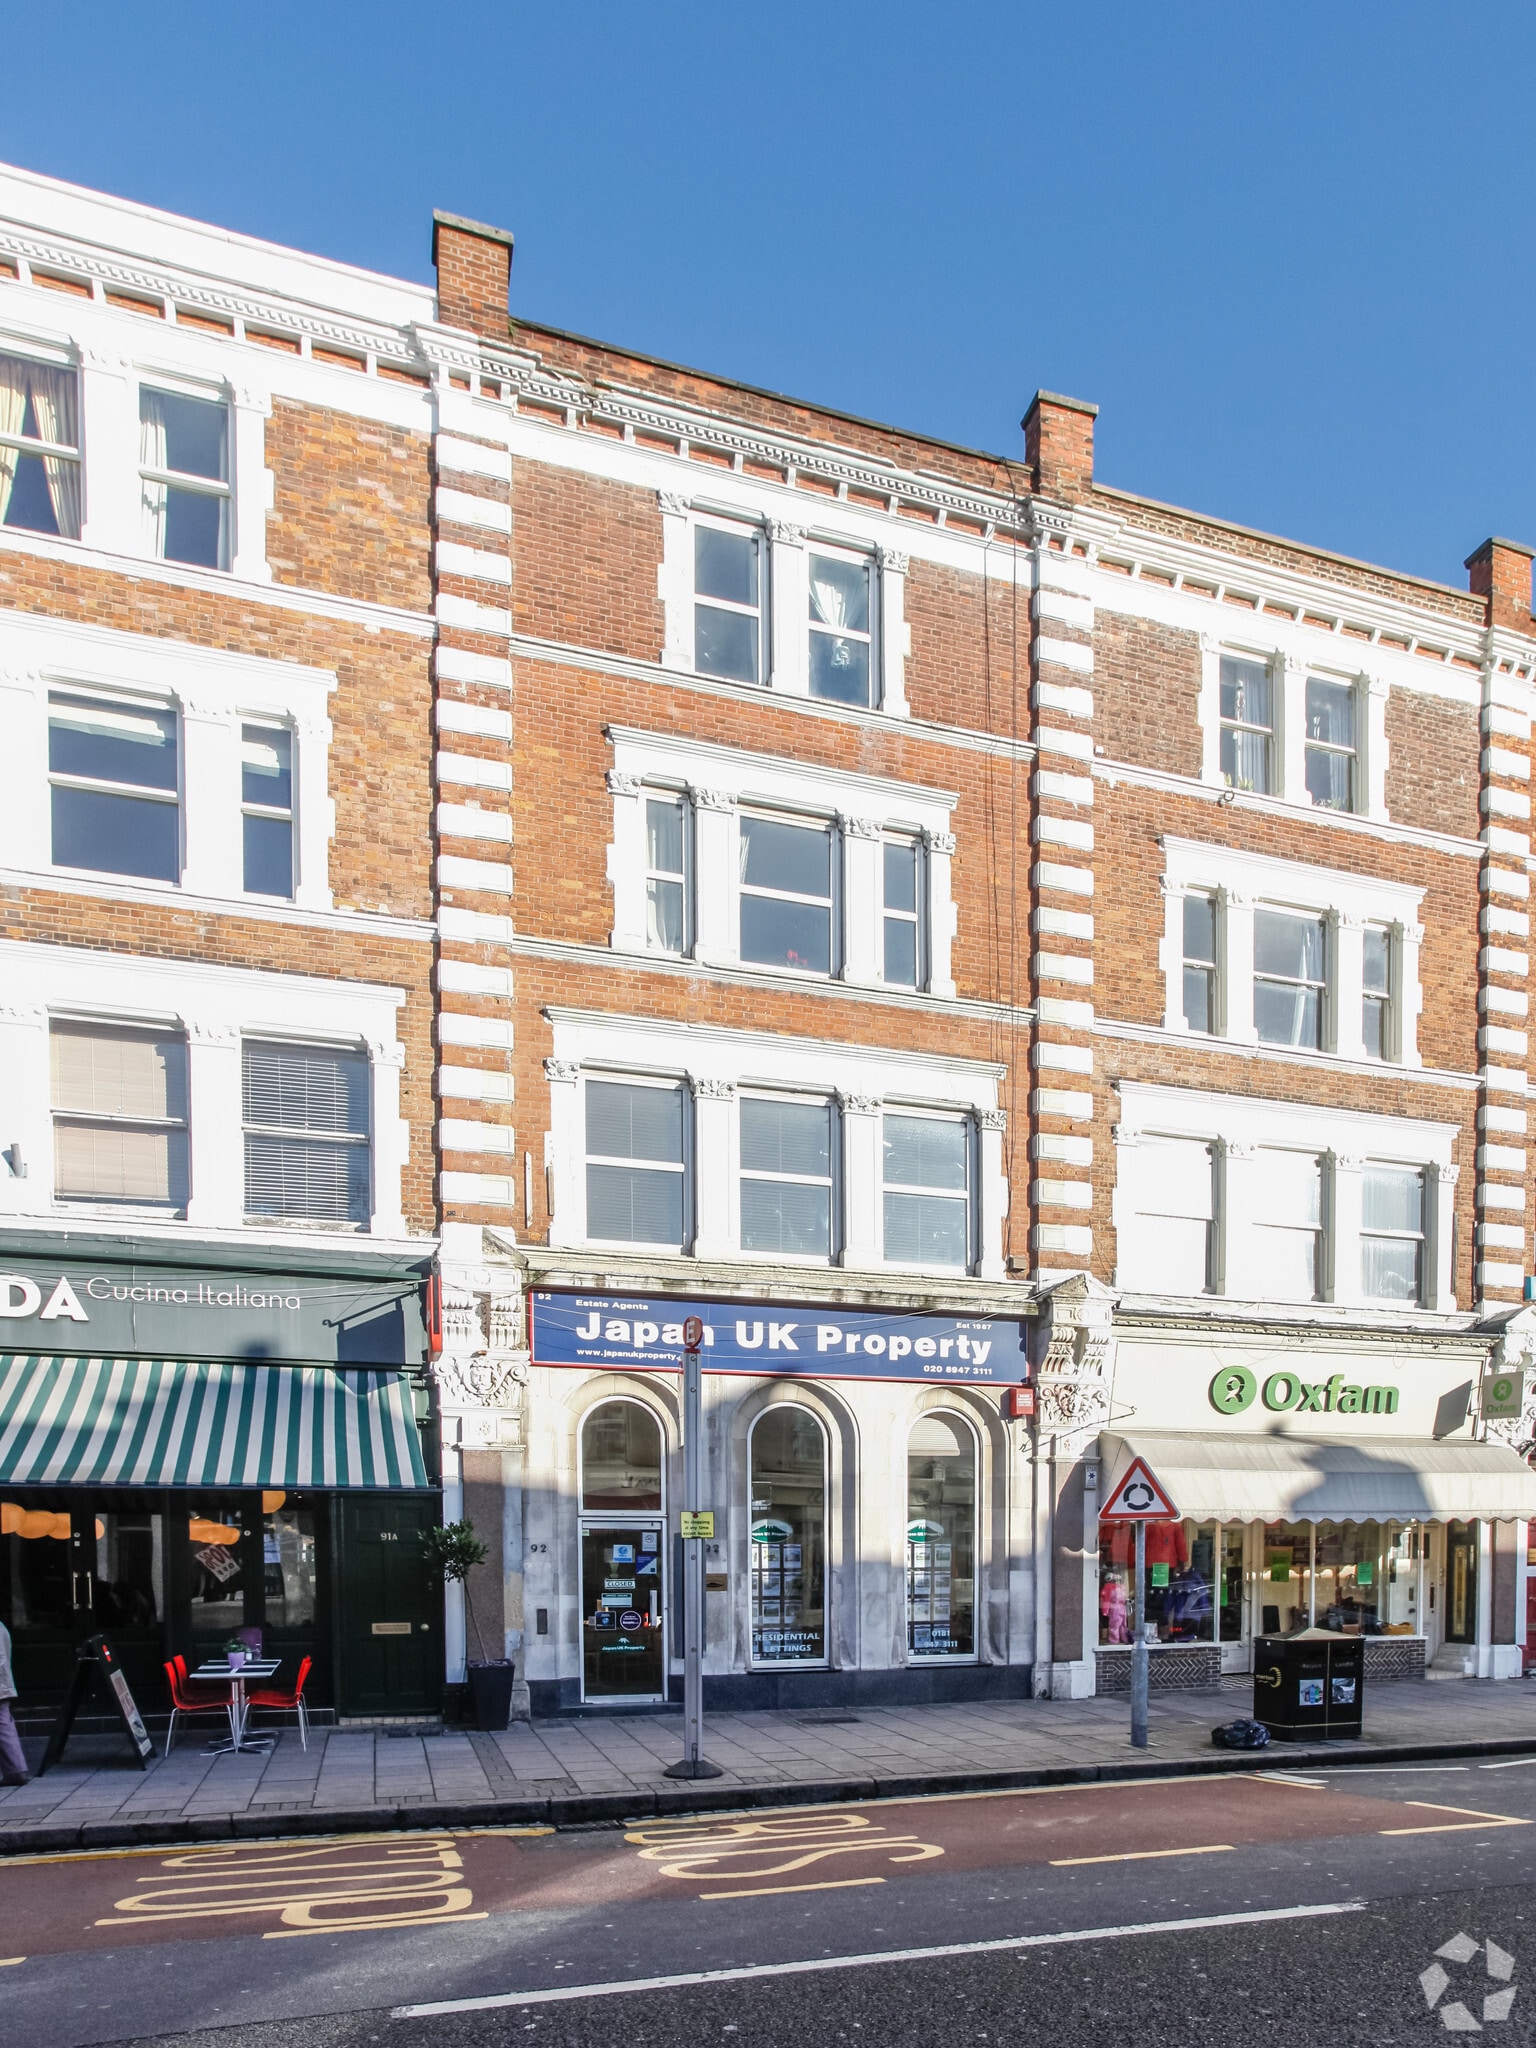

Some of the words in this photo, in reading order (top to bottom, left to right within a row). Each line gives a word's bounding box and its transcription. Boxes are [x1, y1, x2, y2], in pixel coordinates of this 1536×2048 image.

[87, 1277, 188, 1304] Cucina
[199, 1282, 301, 1310] Italiana
[537, 1293, 552, 1301] 92
[575, 1299, 609, 1308] Estate
[612, 1301, 649, 1311] Agents
[686, 1320, 696, 1344] E
[576, 1312, 715, 1348] Japan
[735, 1320, 799, 1350] UK
[816, 1324, 993, 1365] Property
[576, 1349, 682, 1361] www.japanukproperty.
[923, 1364, 943, 1373] 020
[945, 1365, 971, 1374] 8947
[972, 1367, 993, 1375] 3111
[1263, 1371, 1400, 1414] Oxfam
[1486, 1403, 1517, 1413] Oxfam
[380, 1532, 398, 1541] 91A
[530, 1543, 547, 1553] 92
[755, 1632, 820, 1641] RESIDENTIAL
[931, 1629, 950, 1637] 0181
[764, 1644, 812, 1652] LETTINGS
[942, 1640, 958, 1648] 3111
[623, 1814, 945, 1880] BUS
[94, 1839, 474, 1926] STOP
